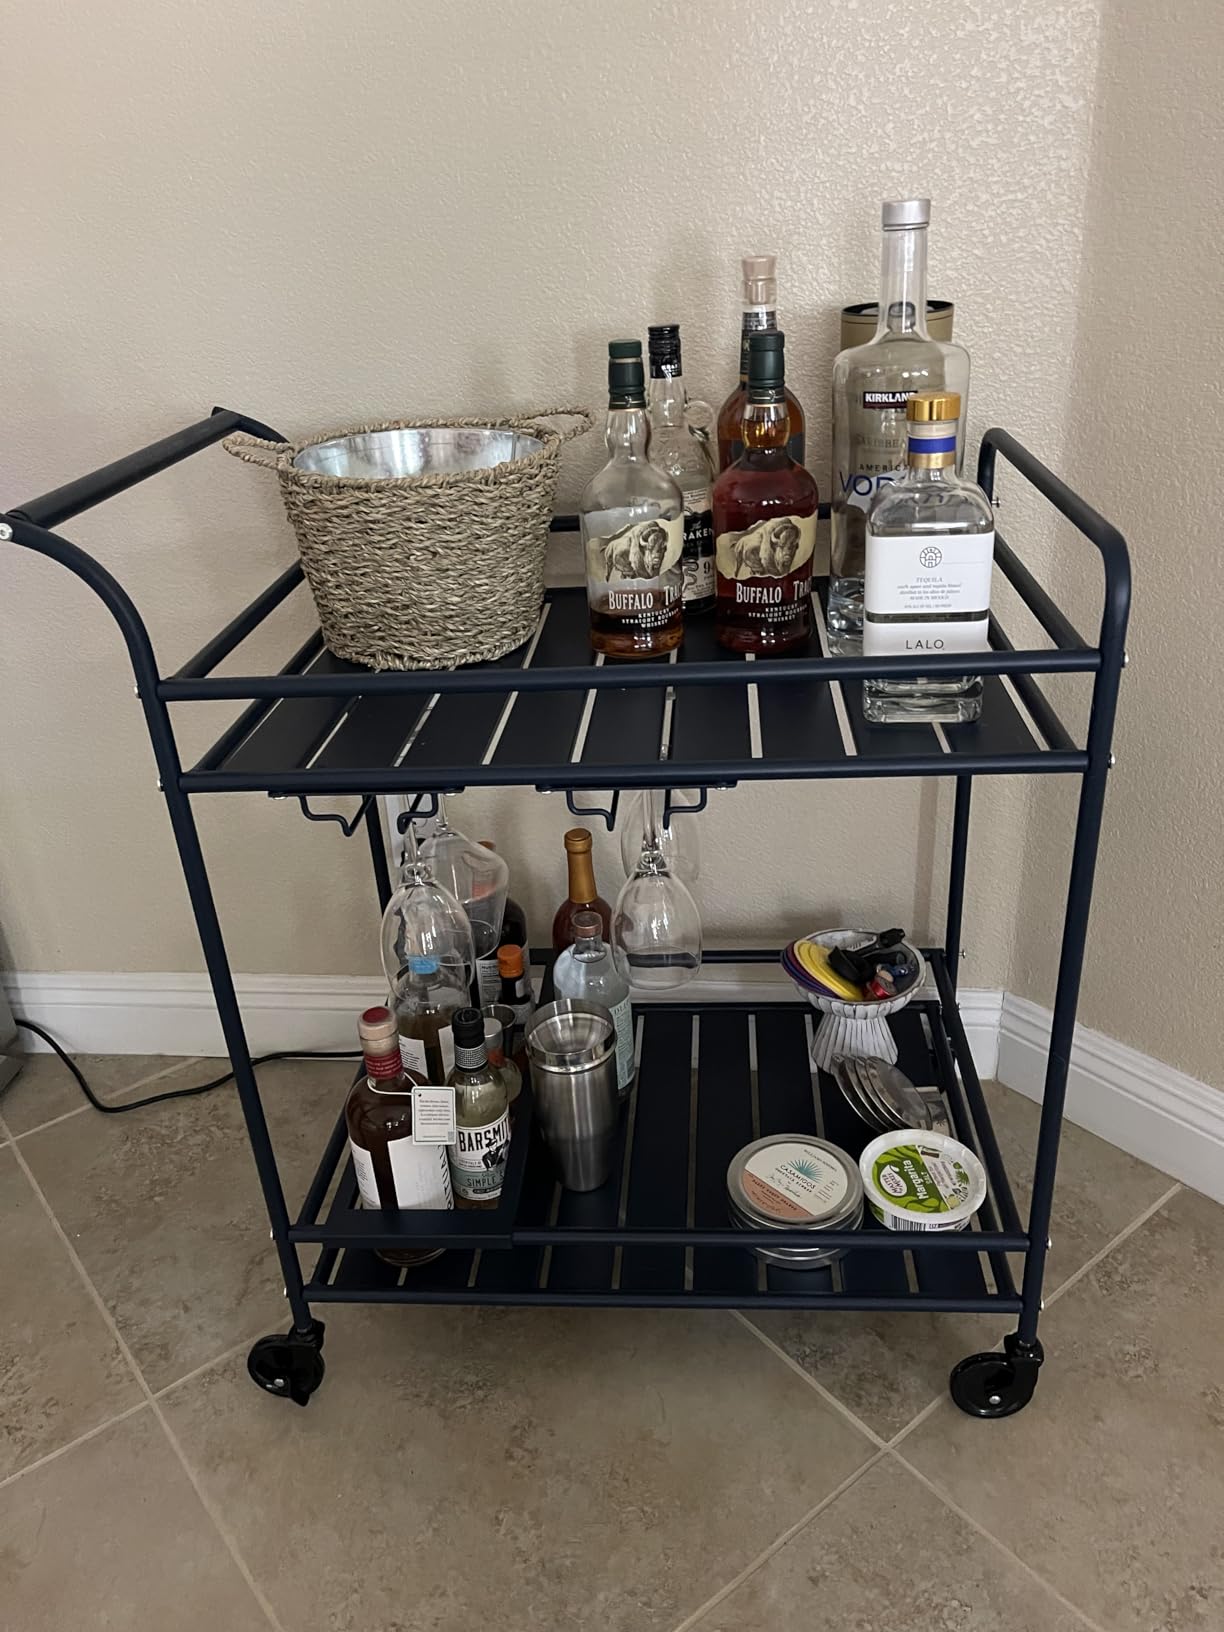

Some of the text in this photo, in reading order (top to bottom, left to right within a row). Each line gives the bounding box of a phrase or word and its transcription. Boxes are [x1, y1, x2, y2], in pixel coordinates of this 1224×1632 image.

[608, 590, 653, 610] BUFFALO
[736, 582, 782, 604] BUFFALO
[638, 608, 670, 618] KENTUCKY
[905, 639, 945, 650] LALO
[467, 1175, 496, 1187] SIMPLE
[780, 1164, 816, 1190] CASAMIGOS
[903, 1160, 929, 1200] Margarita
